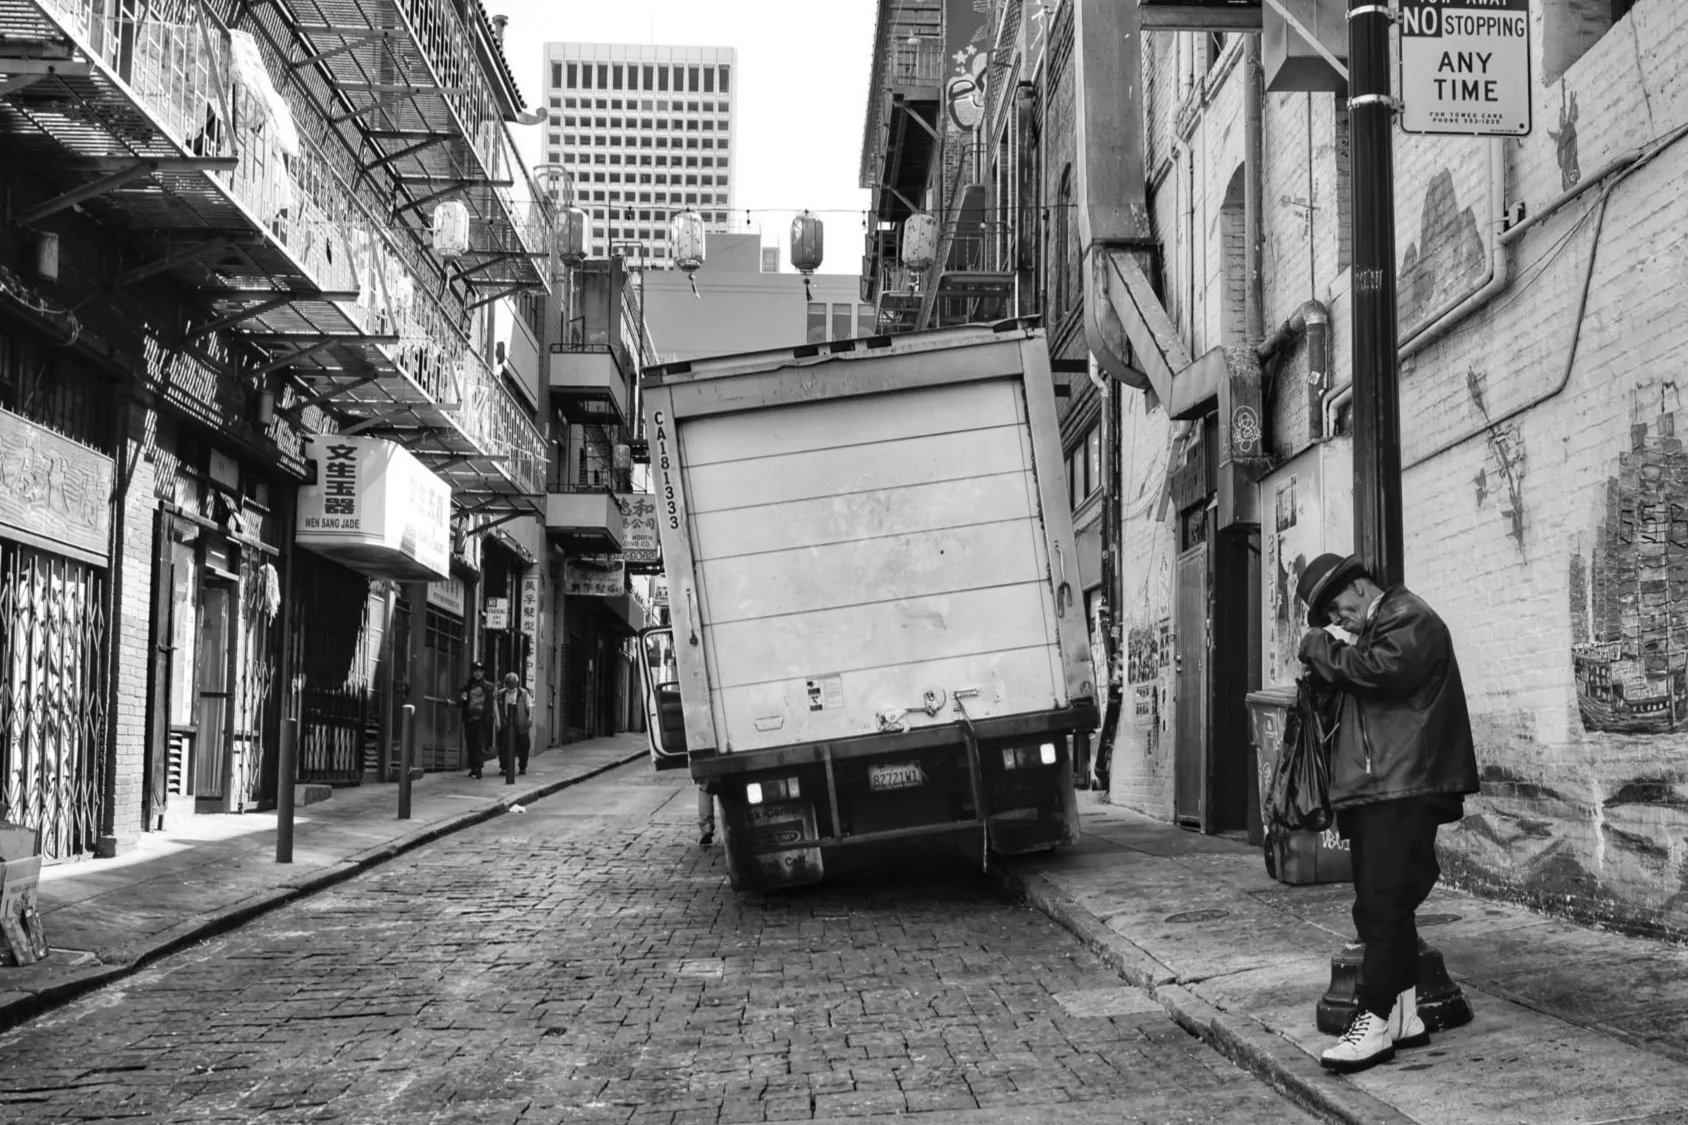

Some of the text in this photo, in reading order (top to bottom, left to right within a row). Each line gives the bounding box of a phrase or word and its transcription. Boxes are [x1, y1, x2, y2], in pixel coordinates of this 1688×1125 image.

[1403, 6, 1525, 37] NO STOPPING
[1438, 51, 1493, 74] ANY
[1433, 79, 1498, 102] TIME
[324, 443, 357, 515] 文生玉器
[654, 411, 679, 529] CA181333
[305, 517, 360, 529] WEN SANG JADE
